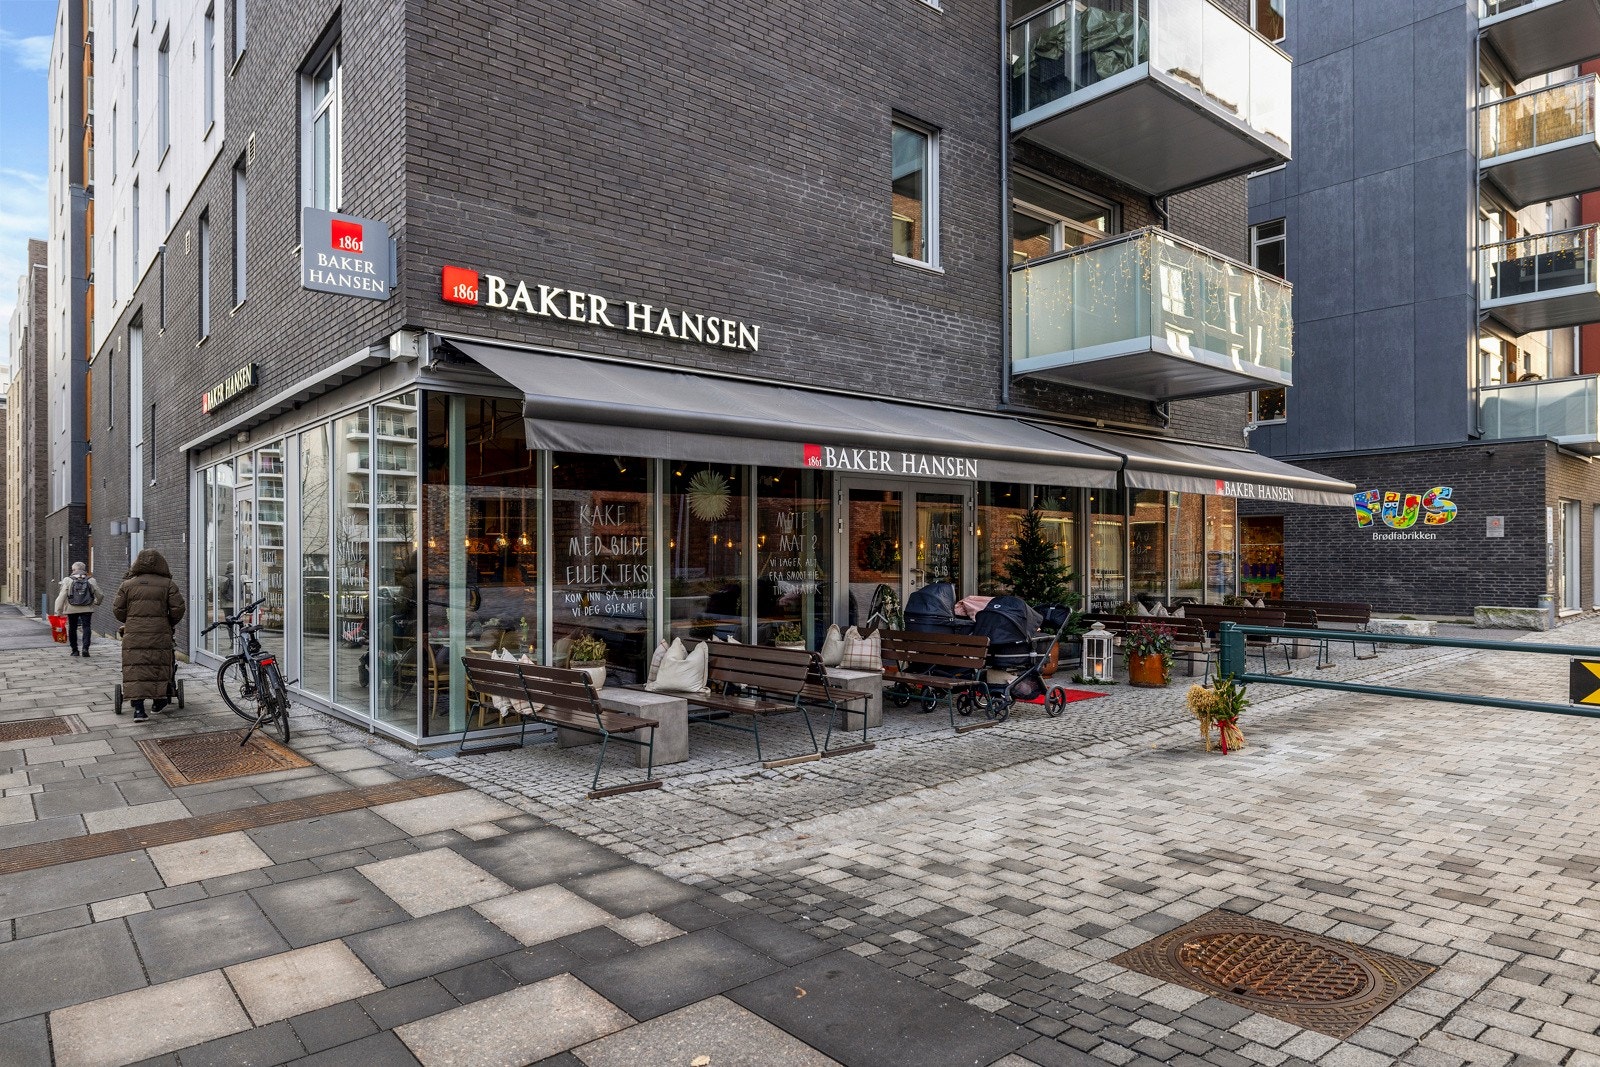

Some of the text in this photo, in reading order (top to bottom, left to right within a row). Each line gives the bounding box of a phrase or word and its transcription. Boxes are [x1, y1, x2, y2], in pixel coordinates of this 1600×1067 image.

[339, 235, 363, 251] 1861
[317, 252, 376, 275] BAKER
[309, 269, 384, 293] HANSEN
[453, 274, 760, 352] 1861 BAKER HANSEN
[225, 363, 251, 400] HANSEN
[807, 446, 978, 478] 1861 BAKER HANSEN
[1224, 481, 1255, 498] BAKER
[1258, 484, 1294, 501] HANSEN
[580, 504, 626, 526] KAKE
[1353, 486, 1458, 529] FUS
[569, 534, 648, 556] MED BILDE
[1372, 531, 1437, 541] Brødfabrikken
[779, 558, 802, 568] LAGER
[566, 564, 653, 585] ELLER TEKST
[565, 593, 584, 603] KOM
[606, 588, 618, 600] SÅ
[584, 605, 600, 616] DEG
